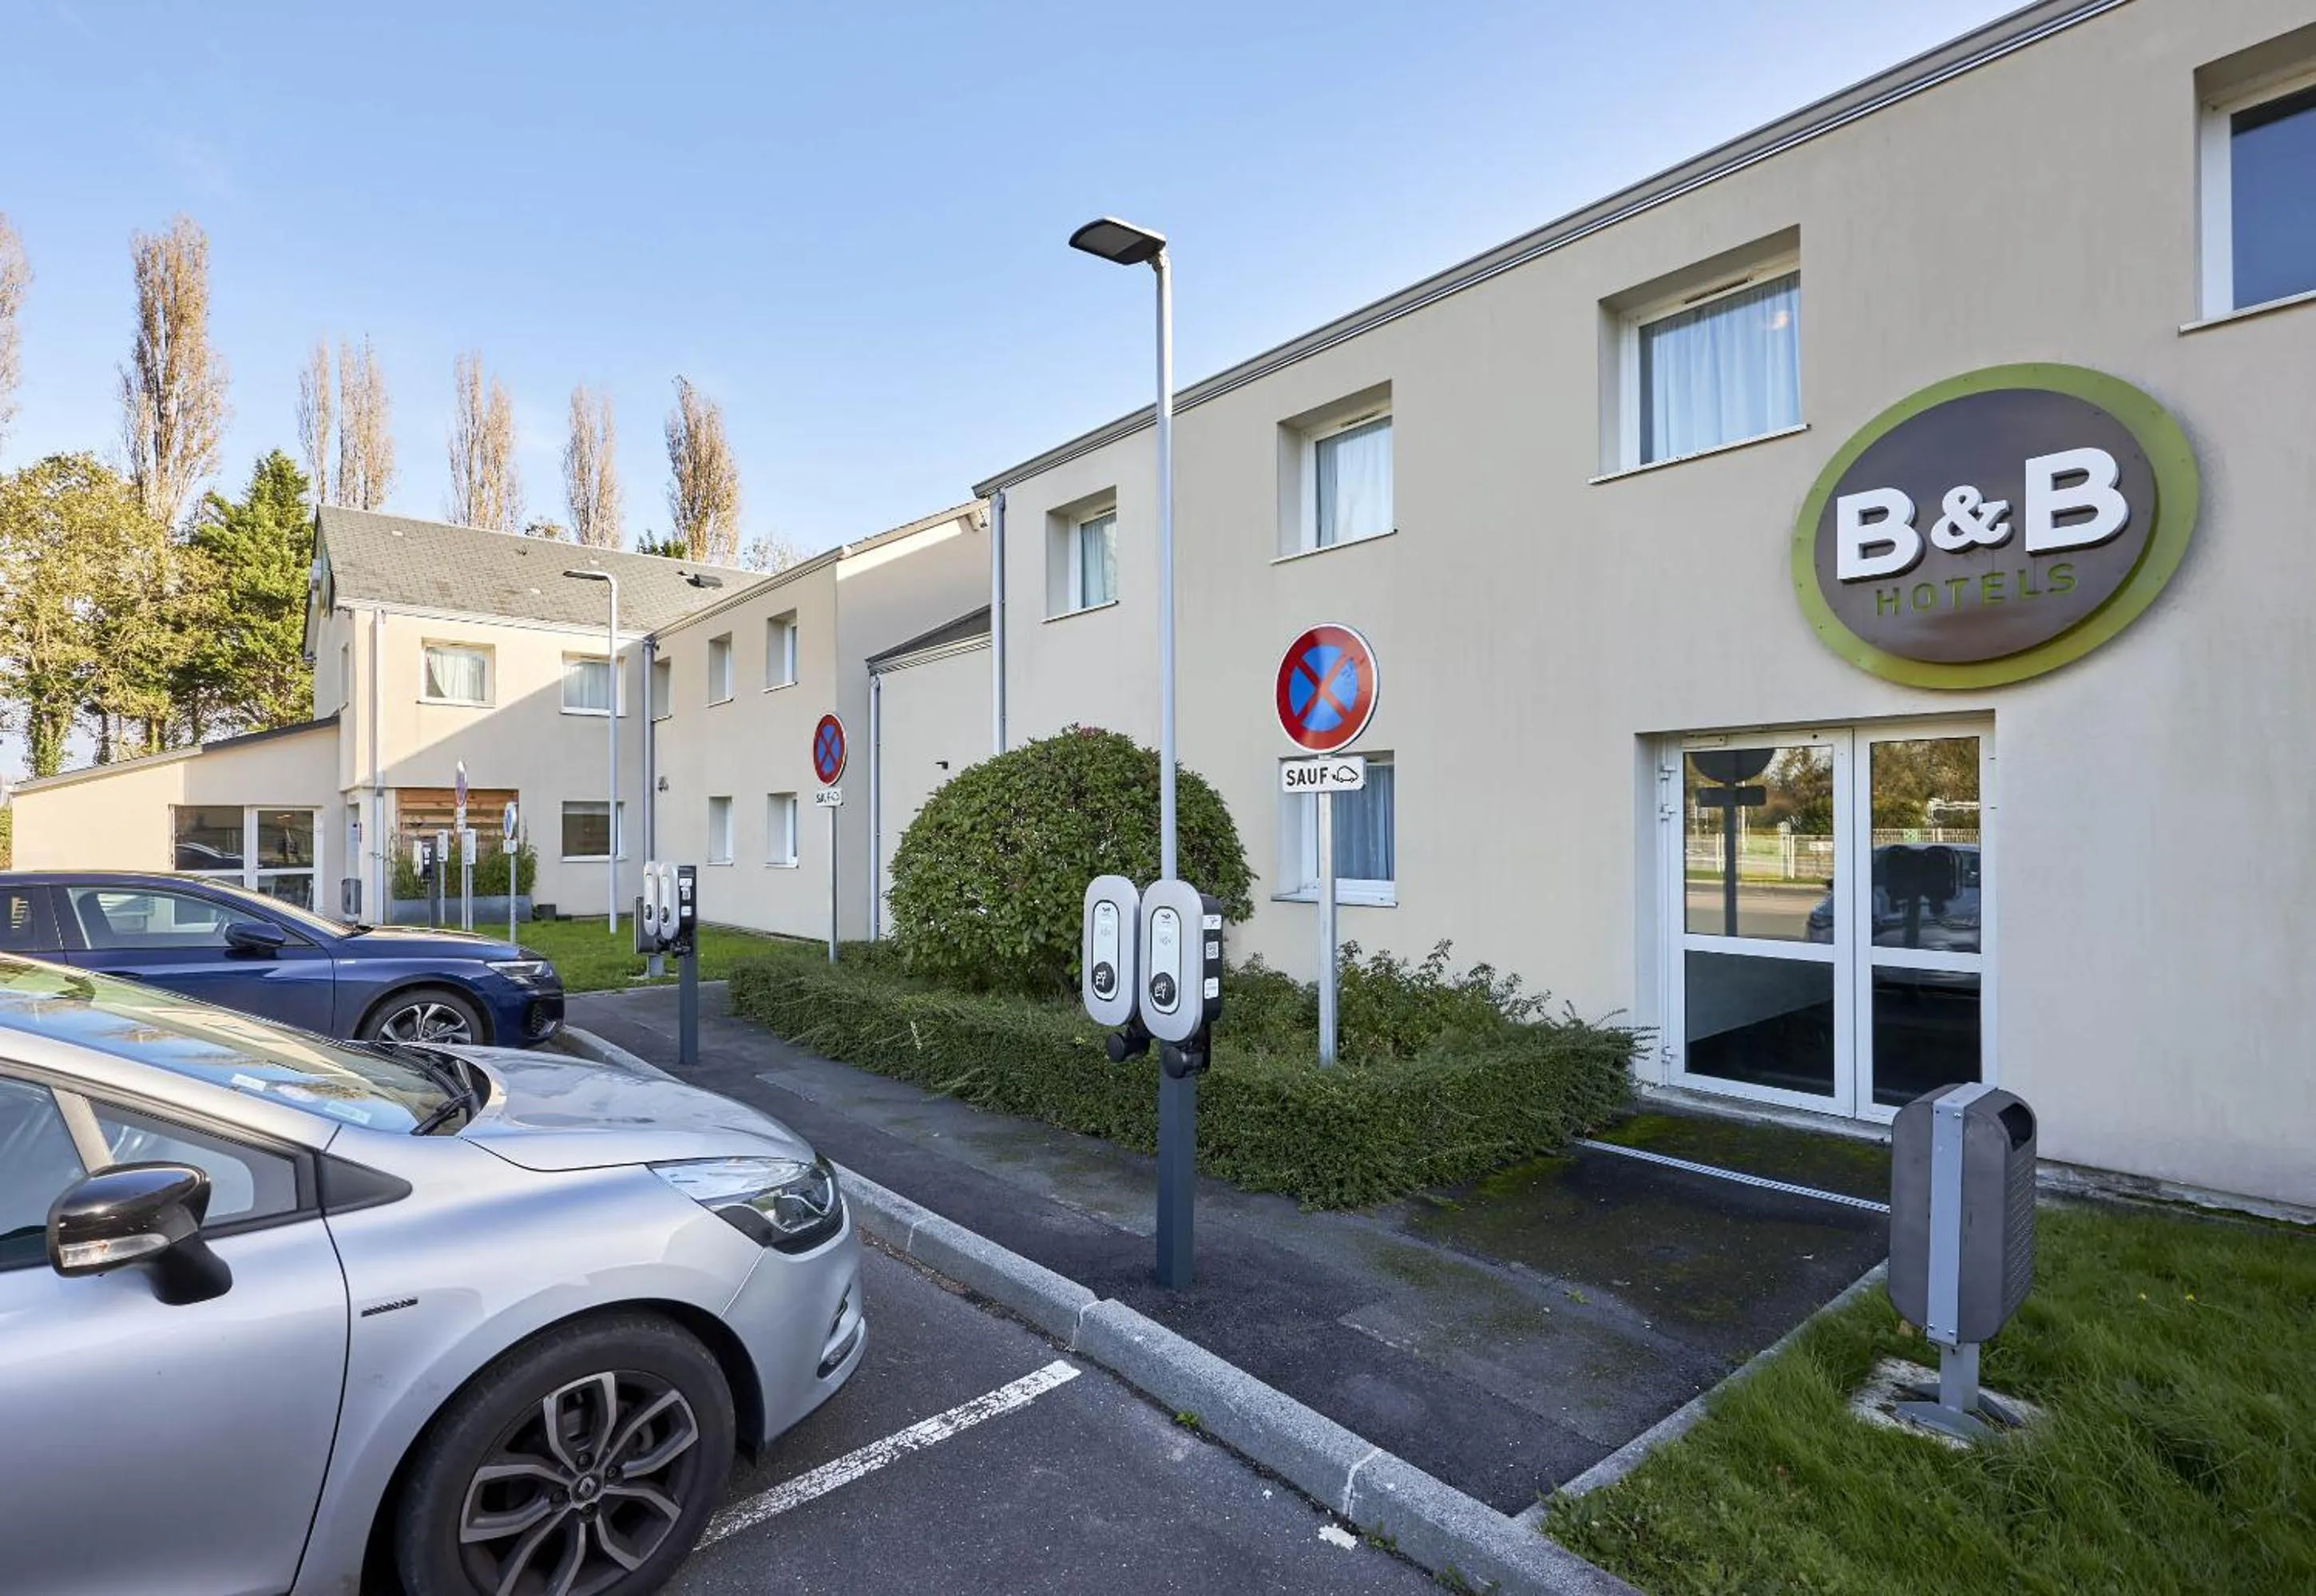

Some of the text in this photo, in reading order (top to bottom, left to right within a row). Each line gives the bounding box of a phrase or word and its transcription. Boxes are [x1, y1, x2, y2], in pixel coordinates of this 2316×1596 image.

[1837, 447, 2130, 581] B&B
[1876, 563, 2076, 617] HOTELS
[1286, 766, 1328, 786] SAUF
